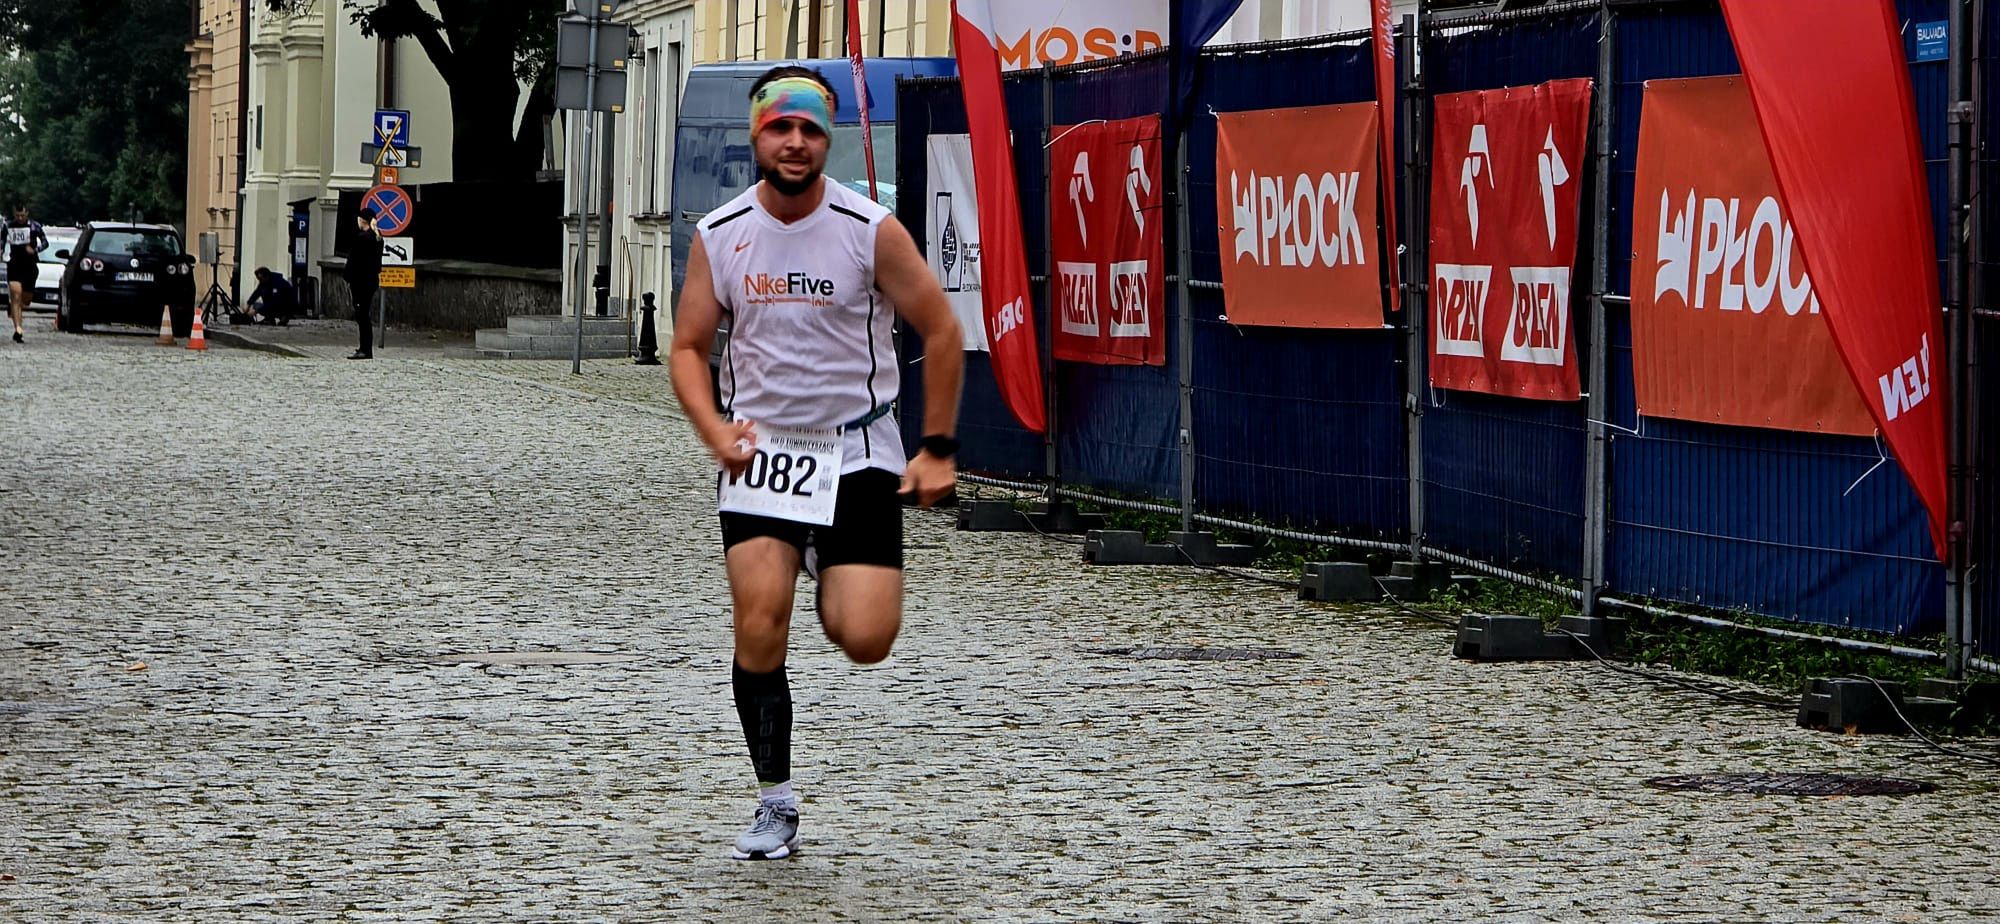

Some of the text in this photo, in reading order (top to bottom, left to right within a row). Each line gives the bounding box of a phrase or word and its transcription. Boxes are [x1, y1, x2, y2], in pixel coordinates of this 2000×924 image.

[299, 220, 306, 231] P
[1260, 171, 1365, 267] PŁOCK
[1694, 196, 1820, 316] PŁOC
[744, 272, 834, 297] NikeFive
[1060, 273, 1096, 325] RLEN
